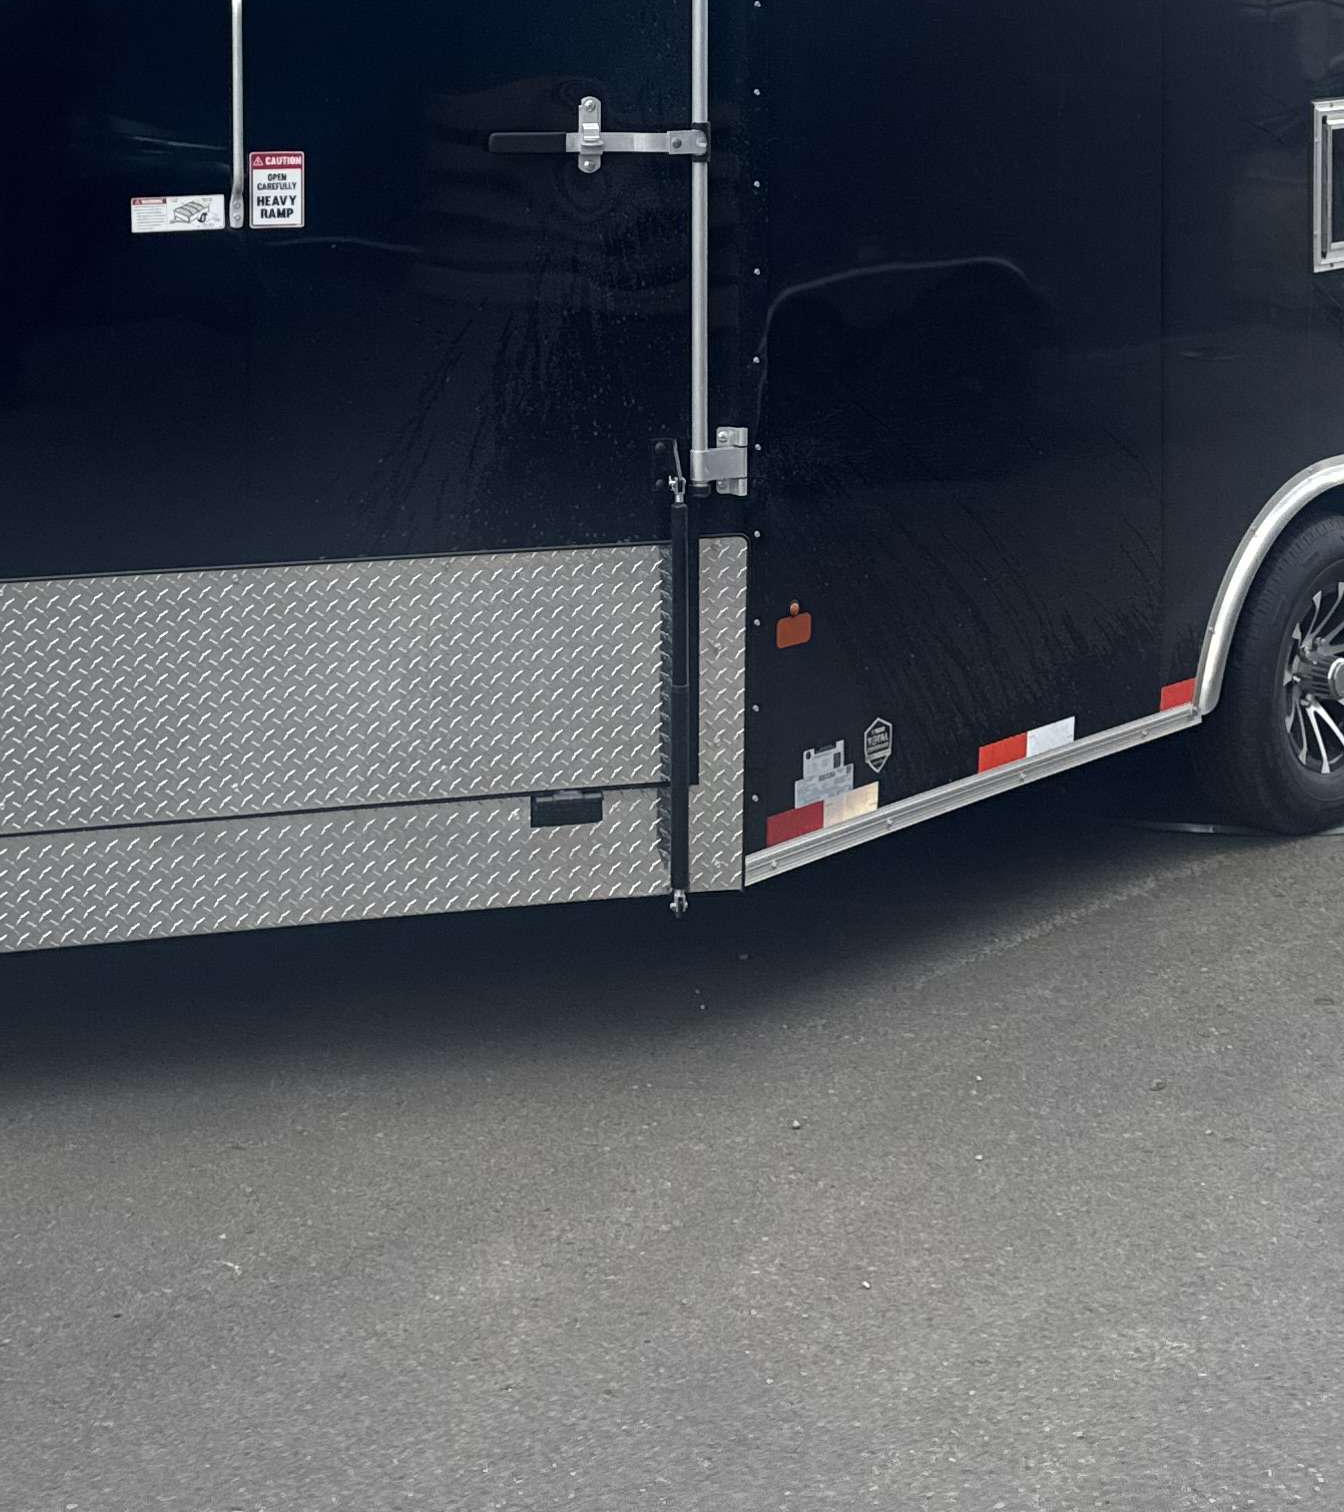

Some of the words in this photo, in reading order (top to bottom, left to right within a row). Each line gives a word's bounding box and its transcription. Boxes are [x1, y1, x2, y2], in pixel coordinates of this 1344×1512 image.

[264, 155, 302, 166] CAUTION
[267, 172, 287, 181] OPEN
[256, 181, 297, 191] CAREFULLY
[256, 194, 297, 207] HEAVY
[260, 207, 294, 219] RAMP
